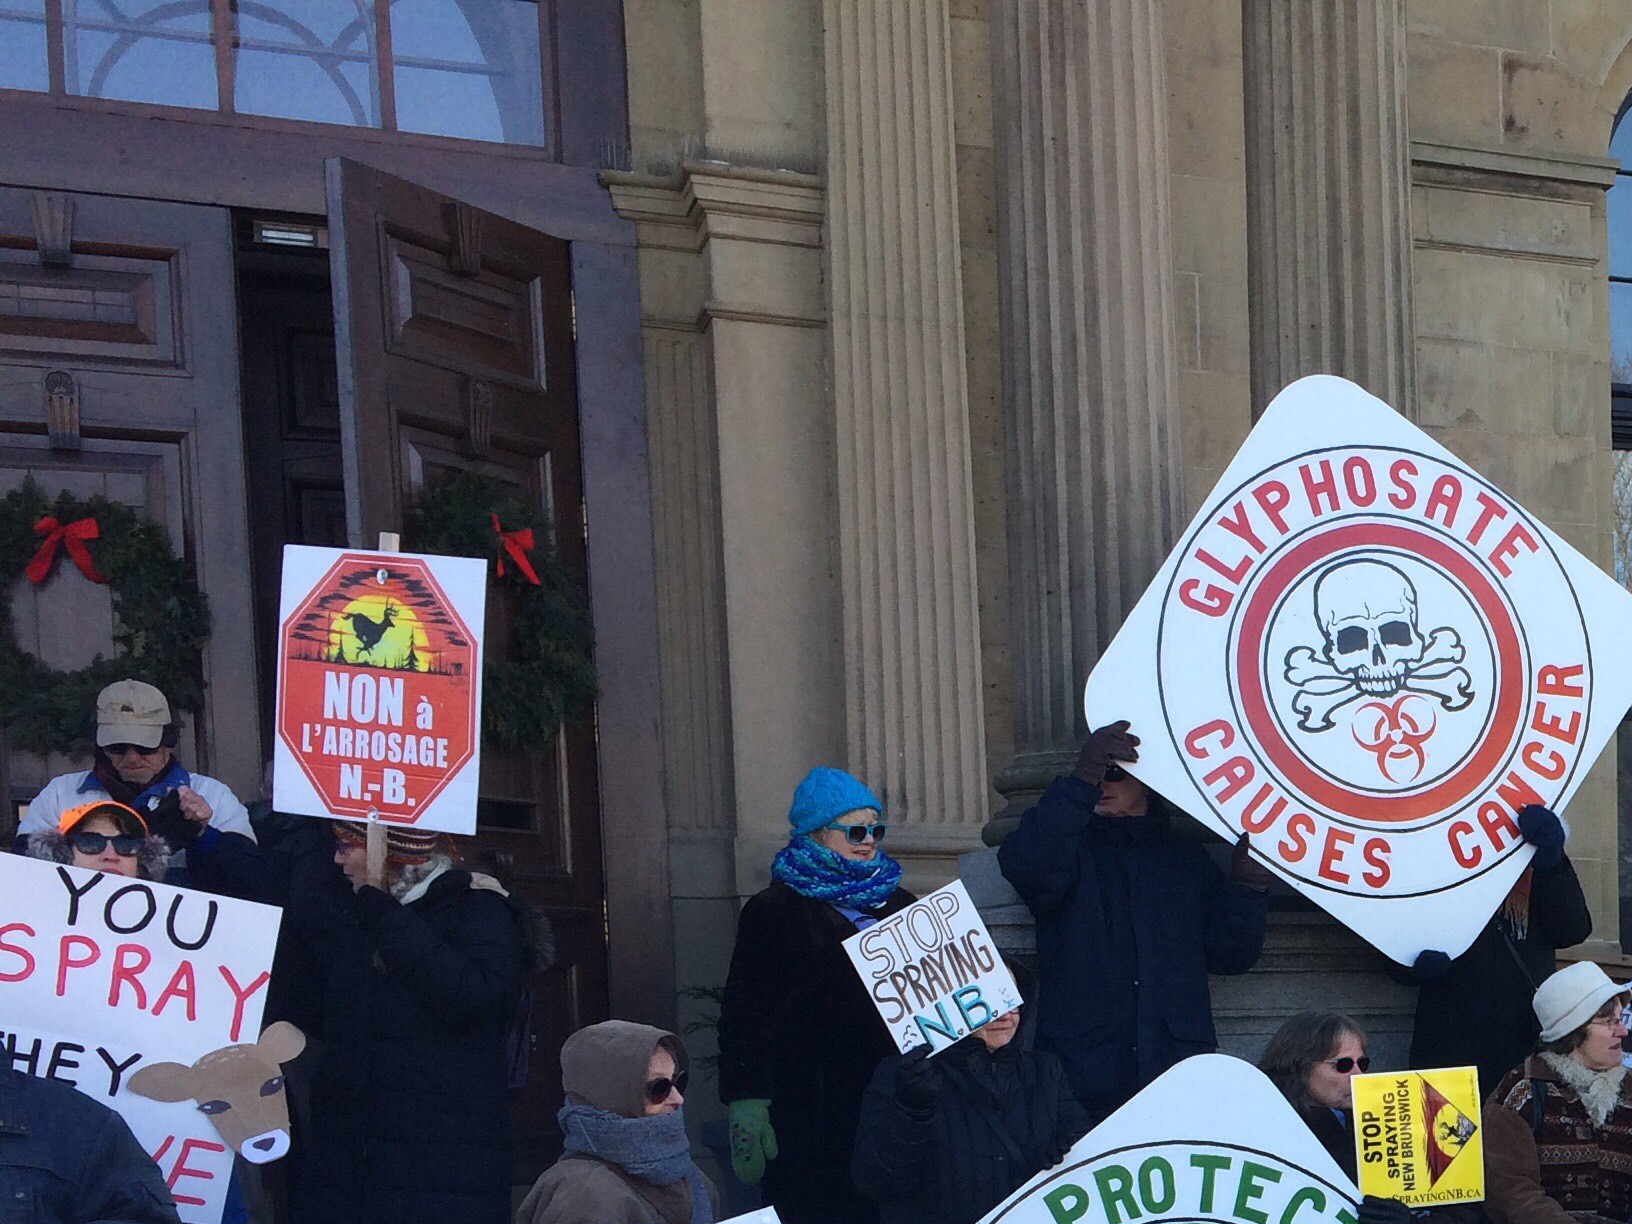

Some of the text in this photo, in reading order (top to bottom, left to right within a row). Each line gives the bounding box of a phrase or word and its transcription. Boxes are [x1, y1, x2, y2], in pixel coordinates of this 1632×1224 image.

[1178, 456, 1540, 618] GLYPHOSATE
[323, 671, 434, 730] NON à
[302, 723, 448, 768] L'ARROSAGE
[1184, 663, 1584, 889] CAUSES CANCER
[57, 866, 218, 950] YOU
[859, 891, 960, 979] STOP
[0, 923, 270, 1042] SPRAY
[873, 929, 995, 1024] SPRAYING
[0, 1031, 142, 1097] HEY
[1362, 1111, 1383, 1163] STOP
[1383, 1092, 1400, 1179] SPRAYING
[1396, 1079, 1415, 1191] NEW BRUNSWICK
